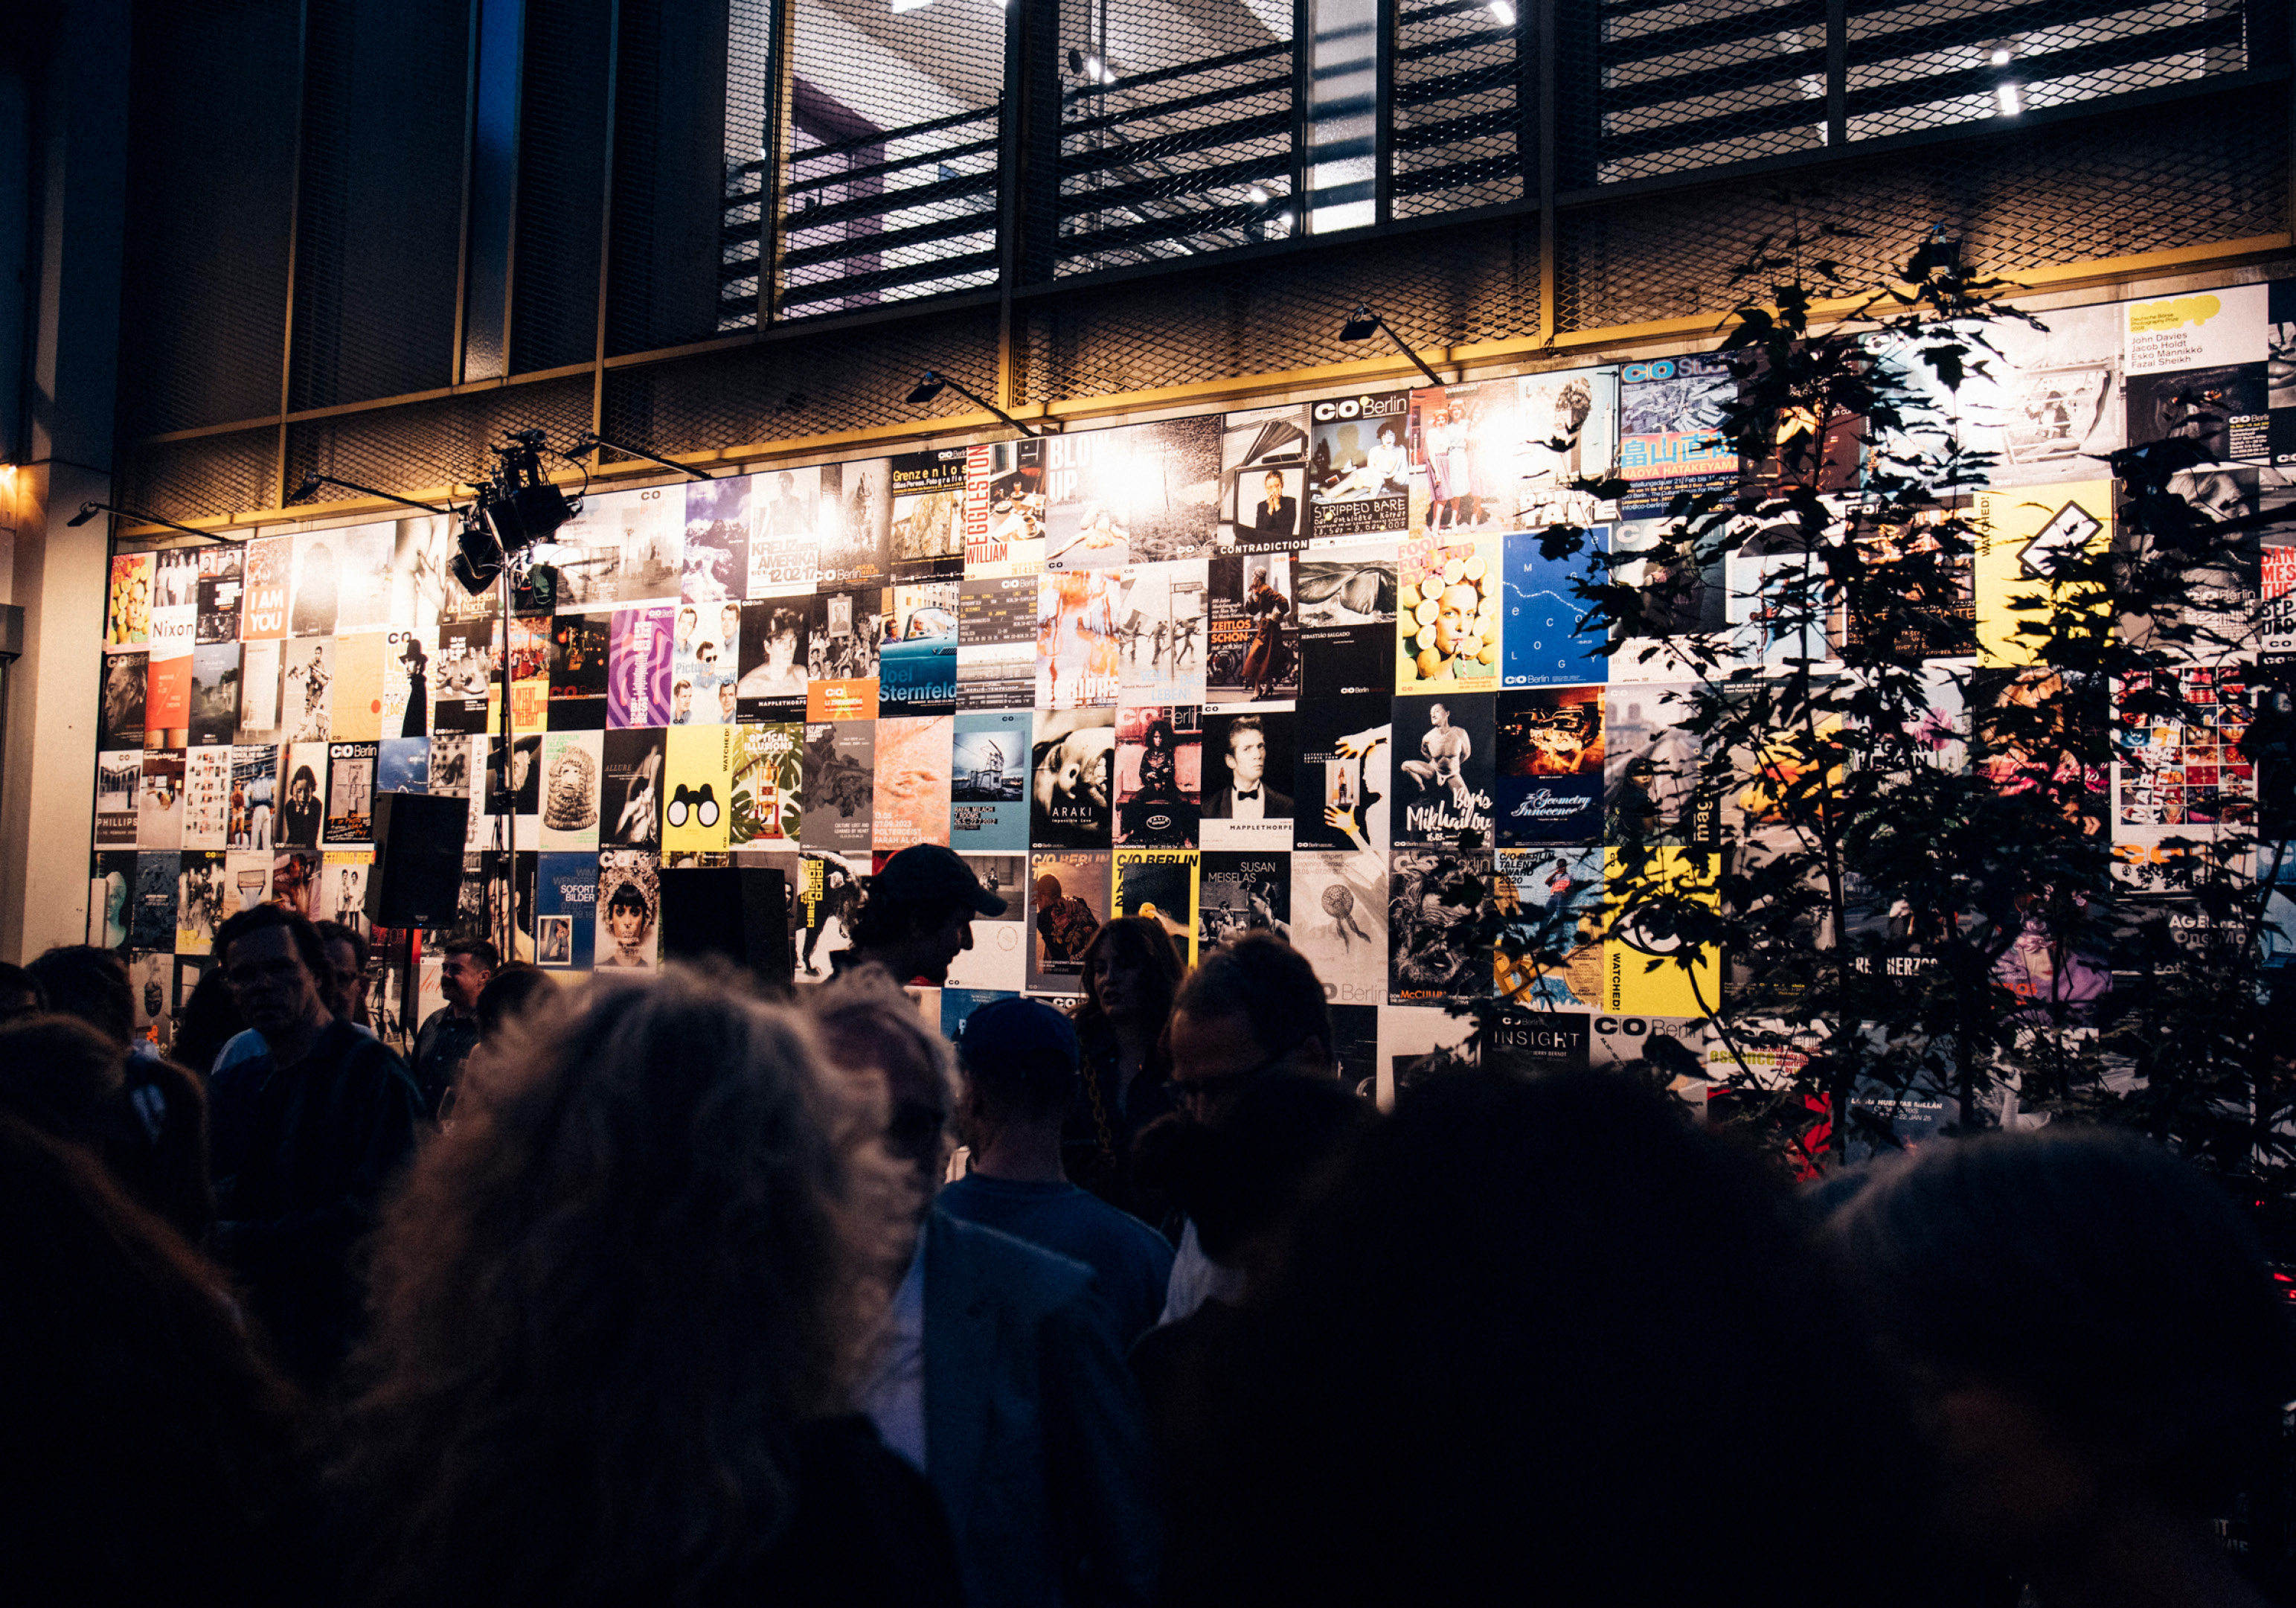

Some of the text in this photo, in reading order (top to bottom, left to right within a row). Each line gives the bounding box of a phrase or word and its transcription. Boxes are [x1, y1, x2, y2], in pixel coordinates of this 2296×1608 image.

[2132, 333, 2187, 345] John Davies
[2132, 340, 2187, 353] Jacob Holdt
[2131, 352, 2155, 361] Esko
[2131, 356, 2191, 368] Fazal Sheikh
[1362, 395, 1408, 416] Berlin
[893, 464, 966, 482] Grenzenlos
[1621, 461, 1739, 479] NAOYA HATAKEYAMA
[1049, 470, 1079, 501] UP
[968, 444, 990, 545] EGGLESTON
[1314, 497, 1406, 519] STRIPPED BARE
[1981, 496, 1991, 557] WATCHED!
[966, 542, 1008, 565] WILLIAM
[1220, 539, 1308, 554] CONTRADICTION
[1398, 536, 1445, 560] FOOD
[757, 551, 816, 570] AMERIKA
[1398, 541, 1476, 574] FOR THE
[1019, 578, 1038, 588] Berlin
[1399, 564, 1446, 587] EYES
[258, 589, 284, 610] AM
[153, 620, 194, 638] Nixon
[250, 611, 283, 632] YOU
[1211, 618, 1251, 632] ZEITLOS
[128, 654, 149, 667] Berlin
[676, 661, 711, 674] Picture
[693, 671, 737, 687] Yourself
[880, 668, 913, 684] Joel
[1140, 669, 1205, 687] VOLL DAS
[1527, 674, 1550, 684] Berlin
[879, 682, 957, 702] Sternfeld
[631, 701, 648, 713] BIS
[1162, 707, 1204, 725] Berlin
[748, 732, 790, 743] OPTICAL
[353, 744, 377, 757] Berlin
[722, 728, 731, 772] WATCHED!
[744, 740, 794, 752] ILLUSIONS
[605, 763, 632, 772] ALLURE
[1452, 787, 1494, 810] Boris
[1533, 787, 1592, 812] Geometry
[1052, 807, 1093, 817] ARAKI
[1405, 799, 1494, 833] Mikhailov
[1510, 801, 1579, 817] Innocence
[97, 817, 138, 827] PHILLIPS
[874, 827, 922, 836] POLTERGEIST
[874, 836, 899, 844] FARAH
[323, 851, 355, 865] STUDIO
[1145, 853, 1199, 868] BERLIN
[1317, 853, 1344, 862] Lempert
[1498, 860, 1533, 870] TALENT
[575, 868, 595, 877] WIM
[1240, 862, 1277, 873] SUSAN
[552, 876, 596, 885] WENDERS
[1208, 871, 1257, 884] MEISELAS
[1498, 876, 1524, 885] 2020
[560, 885, 595, 894] SOFORT
[565, 893, 595, 903] BILDER
[1612, 952, 1622, 1012] WATCHED!
[1341, 983, 1388, 1002] Berlin
[1494, 1031, 1580, 1049] INSIGHT
